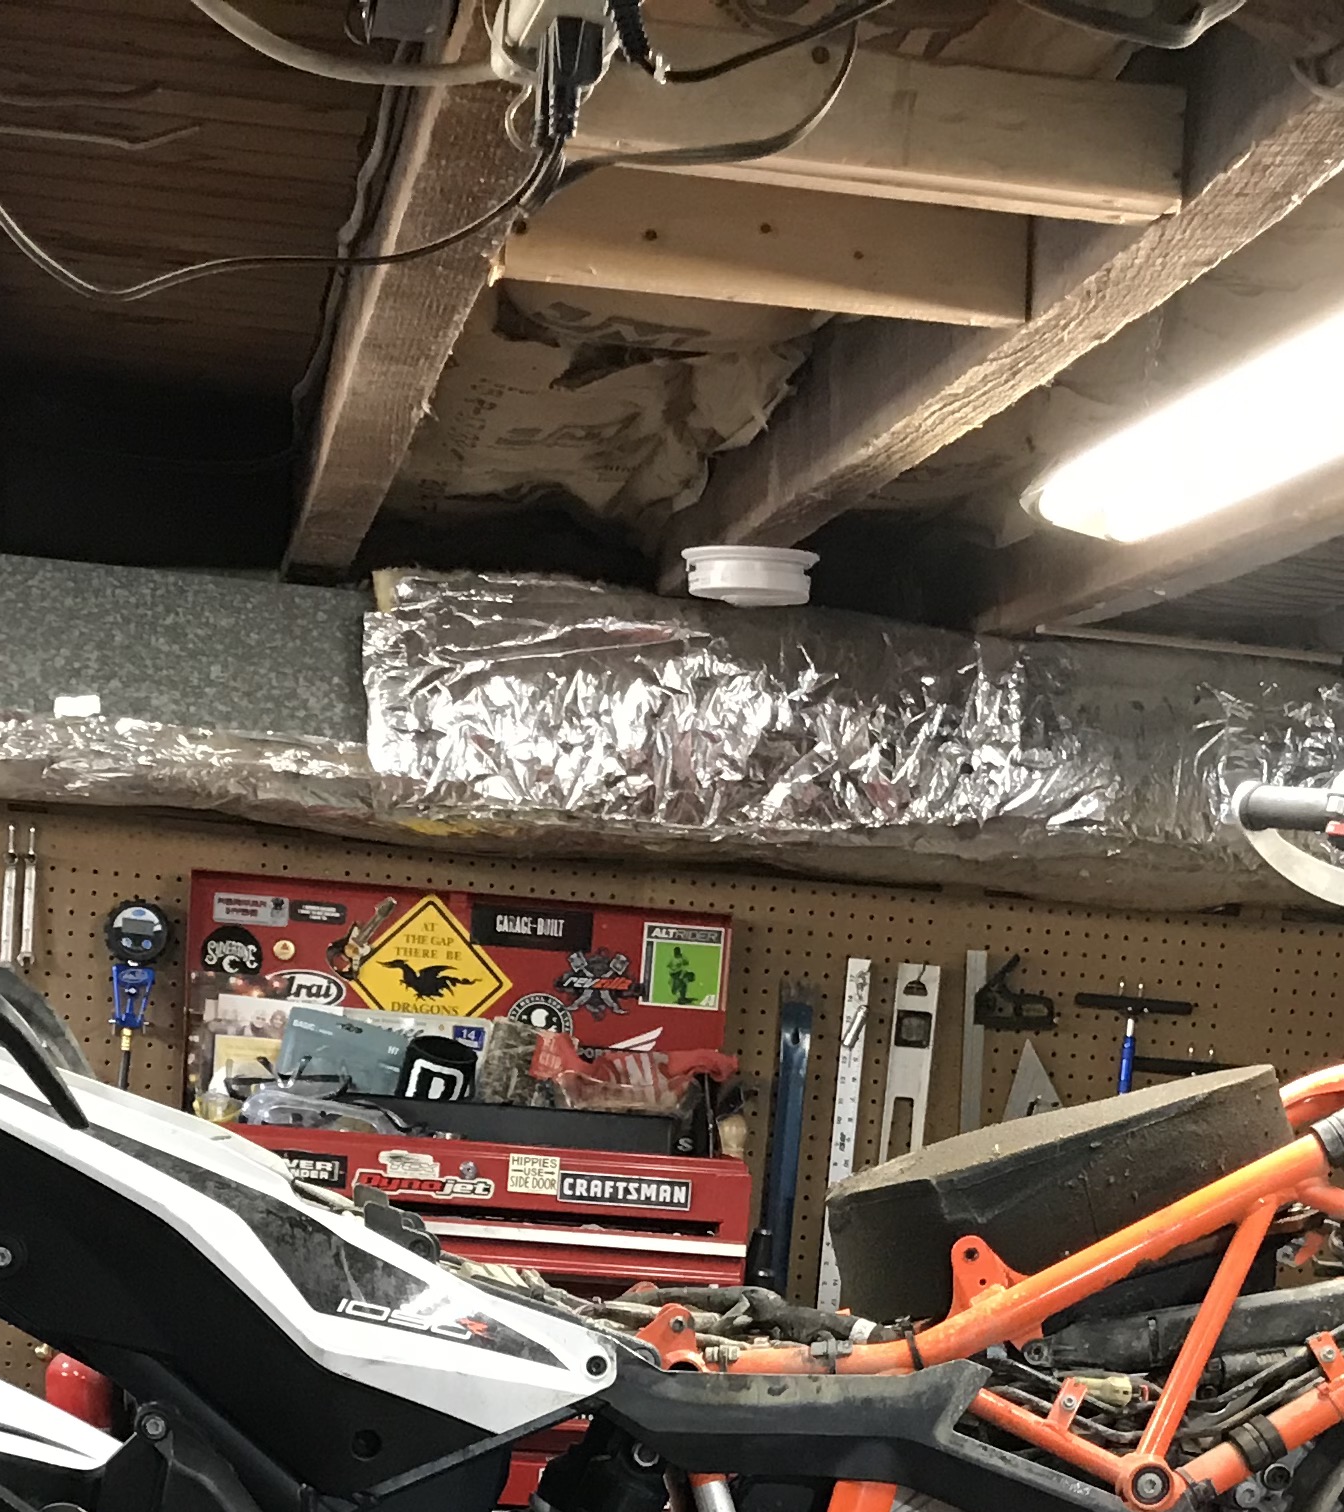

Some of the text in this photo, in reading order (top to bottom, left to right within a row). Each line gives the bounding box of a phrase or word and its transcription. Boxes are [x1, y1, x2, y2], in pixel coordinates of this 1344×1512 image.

[420, 922, 438, 933] AT
[495, 914, 565, 938] GARAGE-BUILT
[403, 934, 455, 947] THE GAP
[651, 927, 719, 941] ALTRIDER
[394, 946, 462, 961] THERE BE
[390, 1001, 460, 1016] DRAGONS
[461, 1028, 476, 1040] 14
[511, 1156, 558, 1168] HIPPIES
[523, 1168, 544, 1177] USE
[509, 1175, 557, 1191] SIDE DOOR
[562, 1177, 687, 1204] CRAFTSMAN
